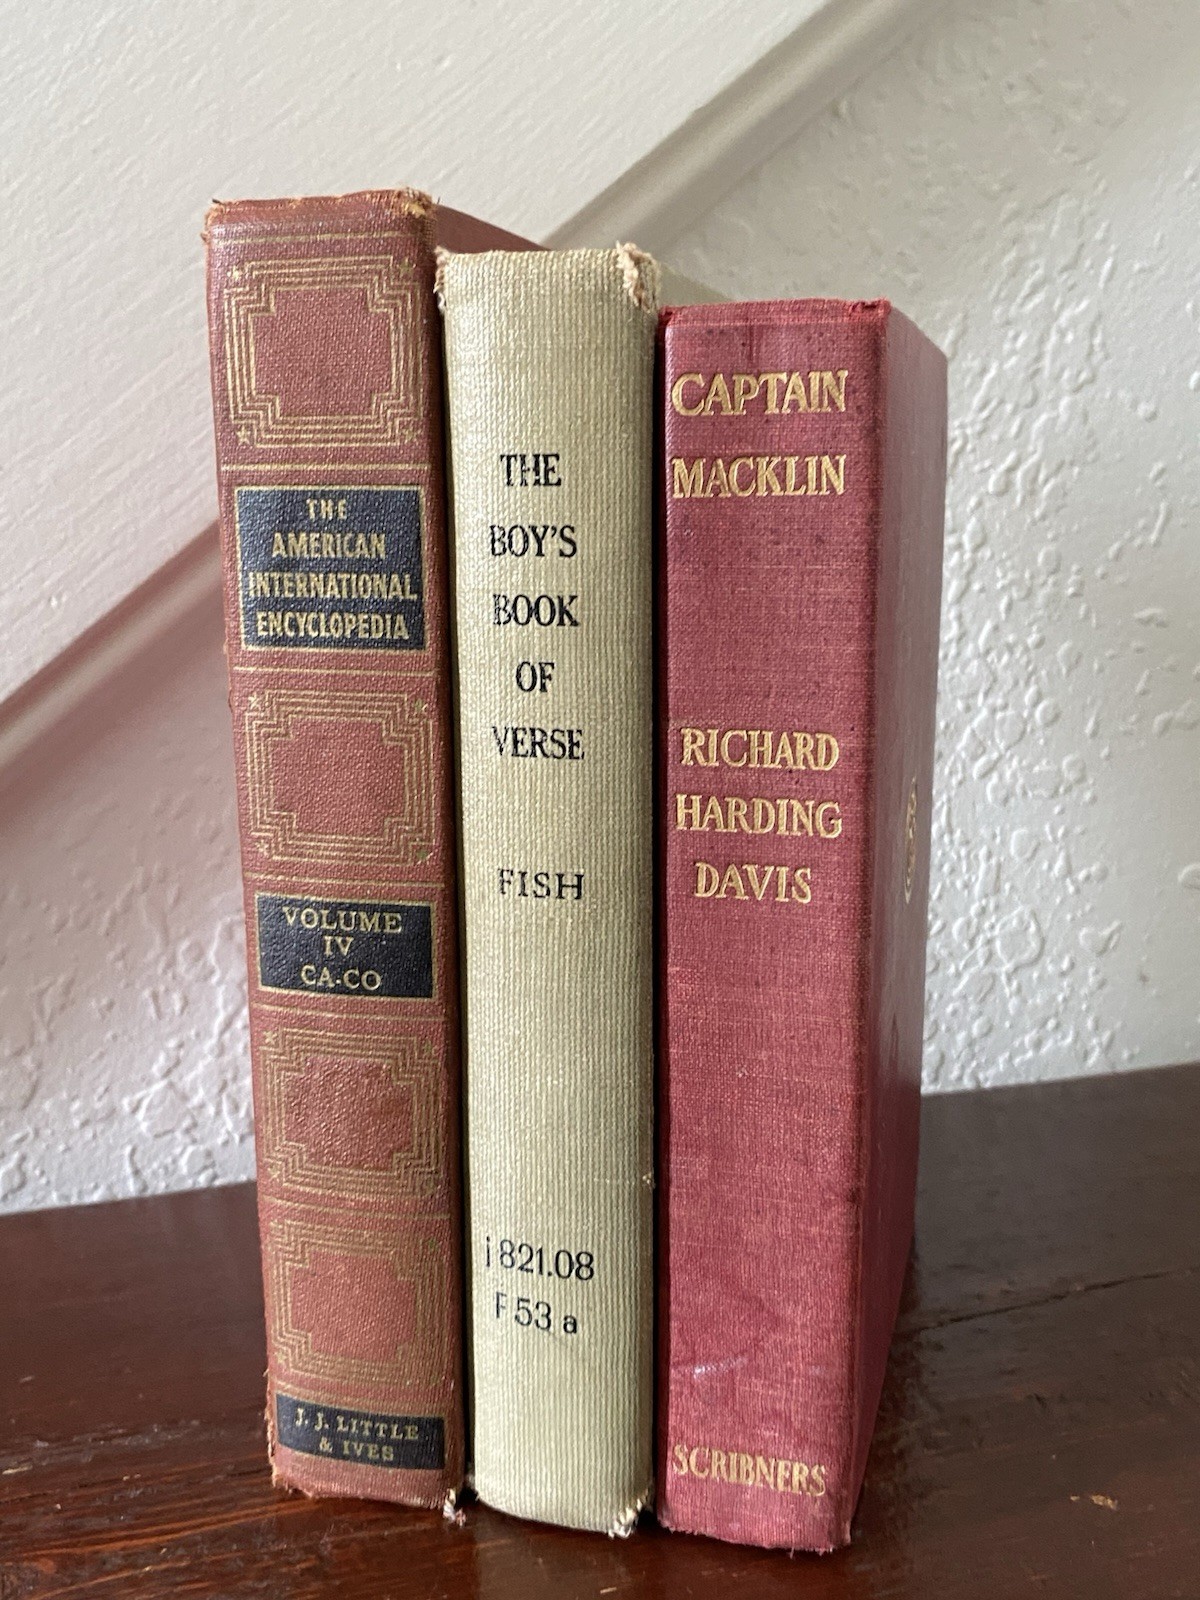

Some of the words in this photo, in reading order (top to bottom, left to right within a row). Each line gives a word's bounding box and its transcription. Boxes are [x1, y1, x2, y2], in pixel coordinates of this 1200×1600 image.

[671, 370, 848, 416] CAPTAIN
[500, 453, 562, 487] THE
[671, 454, 847, 499] MACKLIN
[306, 499, 347, 519] THE
[271, 532, 386, 559] AMERICAN
[489, 524, 578, 558] BOY'S
[249, 572, 418, 600] INTERNATIONAL
[256, 611, 410, 640] ENCYCLOPEDIA
[493, 594, 579, 627] BOOK
[515, 661, 555, 692] OF
[491, 726, 585, 760] VERSE
[680, 727, 840, 771] RICHARD
[675, 794, 843, 839] HARDING
[498, 868, 585, 900] FISH
[694, 862, 812, 904] DAVIS
[282, 906, 403, 934] VOLUME
[324, 935, 355, 956] IV
[336, 1415, 419, 1440] LITTLE
[319, 1437, 333, 1453] &
[342, 1440, 395, 1462] IVES
[672, 1444, 827, 1497] SCRIBNERS
